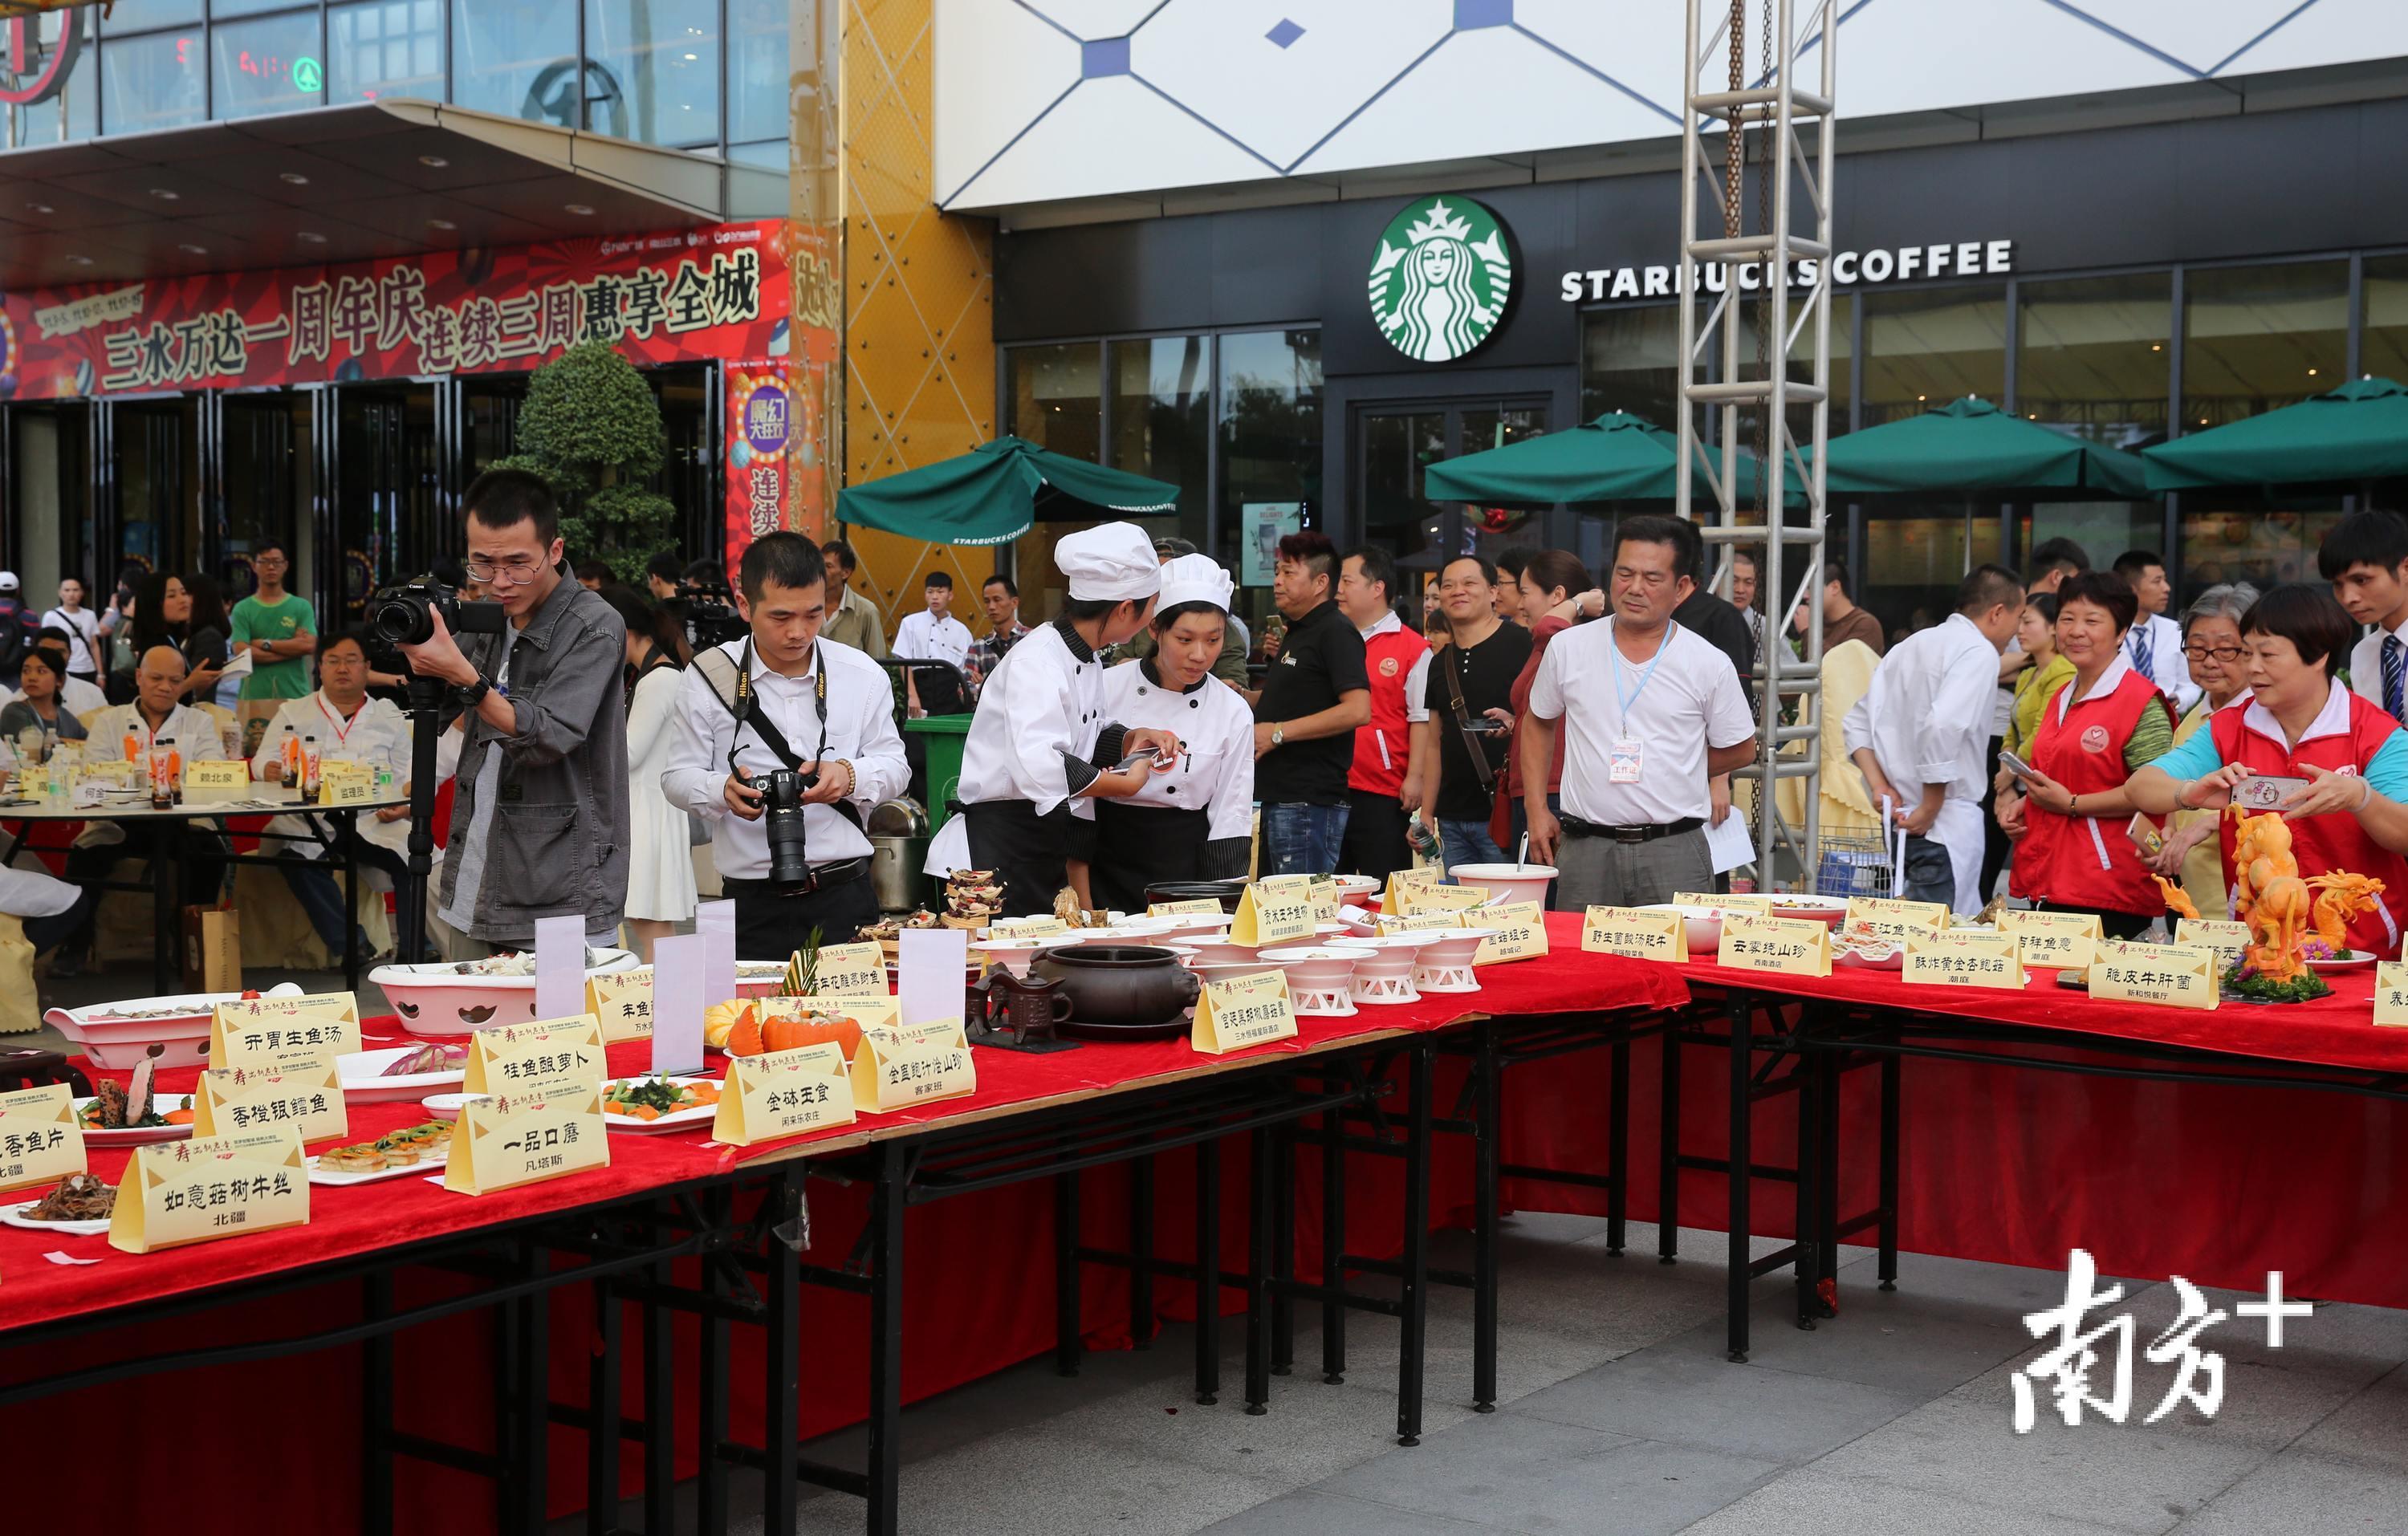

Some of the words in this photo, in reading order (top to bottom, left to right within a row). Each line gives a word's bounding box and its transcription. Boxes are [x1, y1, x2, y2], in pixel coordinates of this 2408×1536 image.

[1832, 240, 2011, 283] COFFEE
[750, 423, 785, 441] 大狂欢
[750, 468, 780, 543] 连续
[953, 534, 1007, 545] STARBUCKS
[1007, 522, 1031, 540] COFFEE
[738, 672, 748, 697] Nikon
[1592, 930, 1667, 949] 野生菌酸汤肥牛
[1733, 940, 1808, 958] 云雾绕山珍
[1754, 958, 1783, 969] 西南酒店
[1914, 956, 2005, 973] 酥炸黄金杏鲍菇
[2105, 968, 2192, 991] 脆皮牛肝菌
[2127, 989, 2169, 1001] 新和悦餐厅
[244, 1025, 343, 1051] 开胃生鱼汤
[502, 1050, 590, 1081] 桂鱼酿萝卜
[232, 1092, 328, 1128] 香橙银鳕鱼
[0, 1127, 65, 1159] 香鱼片
[503, 1121, 580, 1153] 一品口蘑
[525, 1154, 563, 1173] 凡塔斯
[164, 1171, 293, 1213] 如意菇树牛丝
[213, 1209, 247, 1227] 北疆
